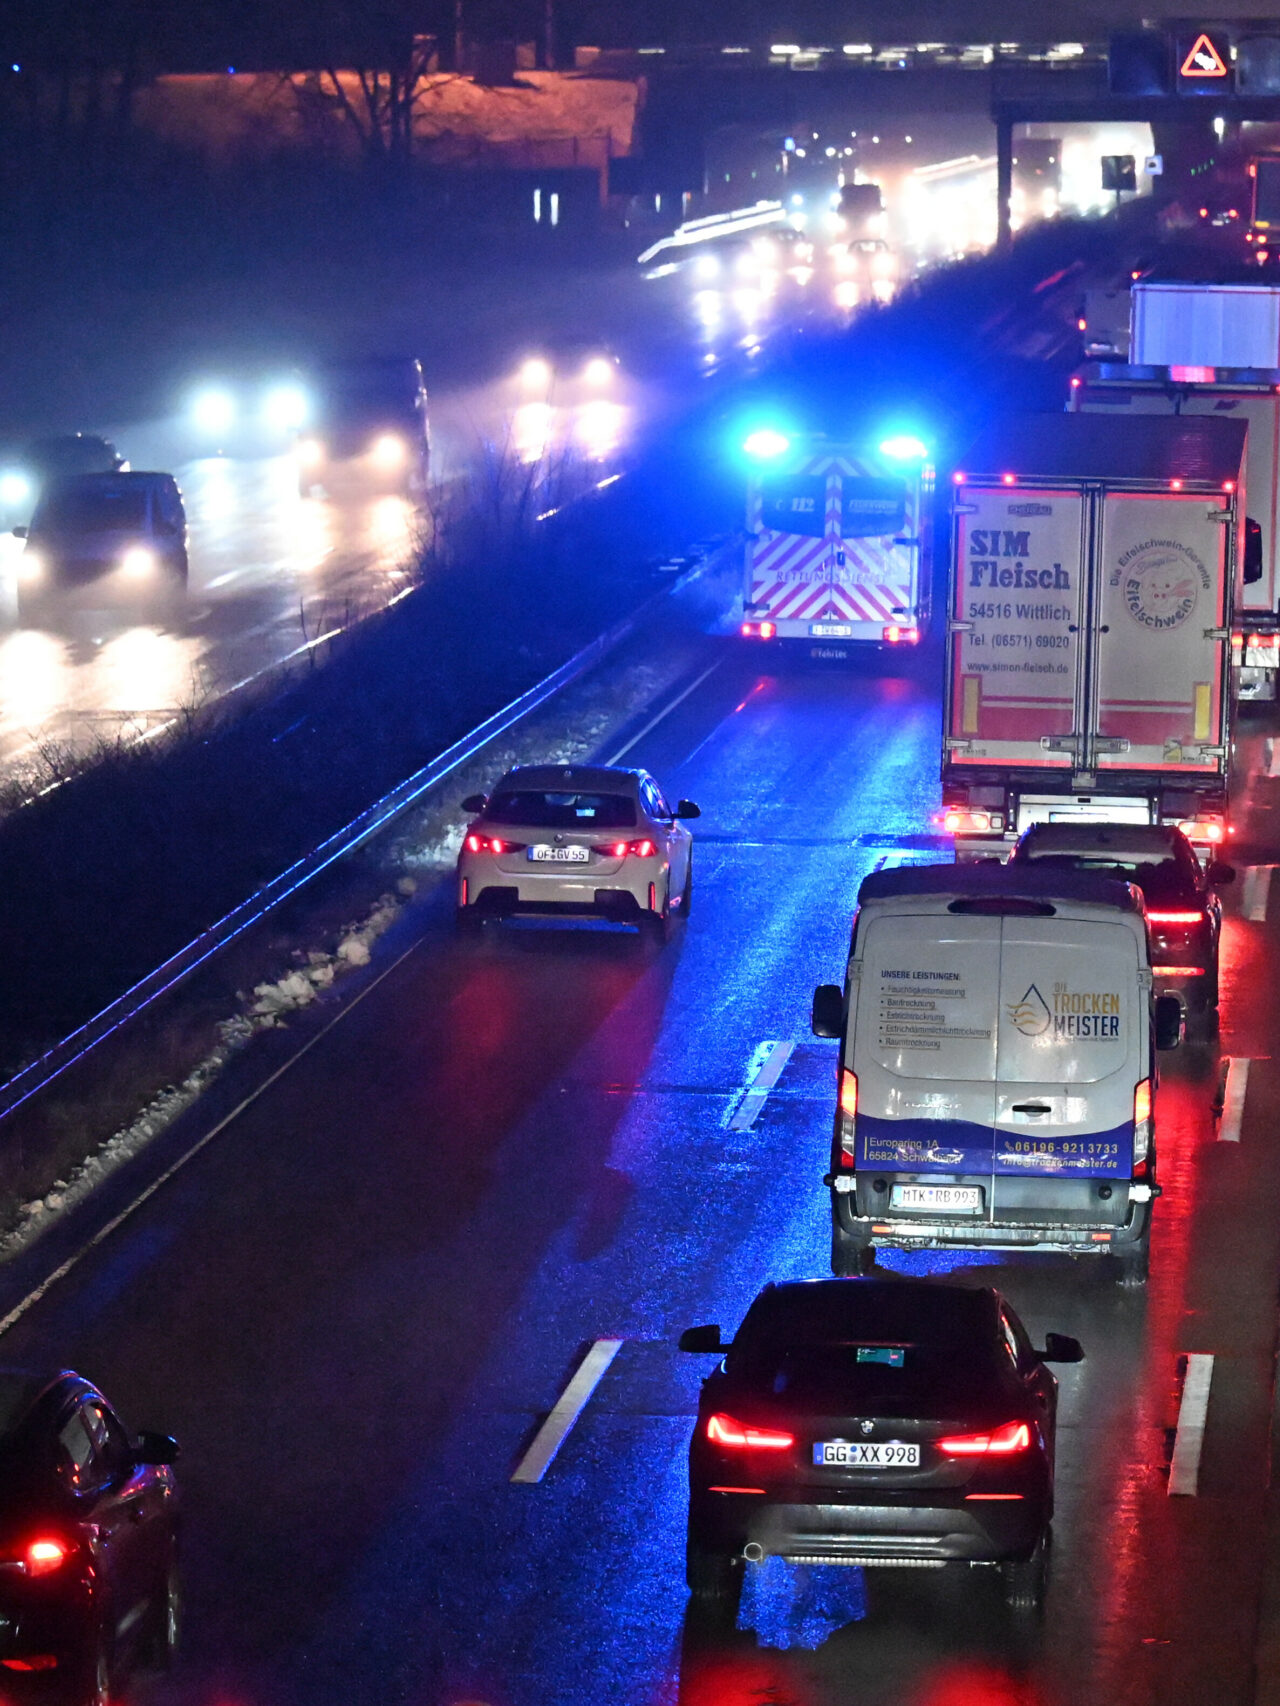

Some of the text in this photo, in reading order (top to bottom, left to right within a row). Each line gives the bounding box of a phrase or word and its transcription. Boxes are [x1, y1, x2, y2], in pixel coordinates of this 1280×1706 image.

[970, 530, 1031, 557] SIM
[969, 561, 1071, 590] Fleisch
[1126, 579, 1193, 628] Eifelschwein
[969, 603, 1071, 621] 54516 Wittlich
[991, 634, 1033, 650] (06571)
[1035, 636, 1070, 649] 69020
[967, 662, 1069, 674] www.simon-fleisch.de
[537, 850, 551, 860] OF
[556, 850, 571, 860] GV
[881, 970, 911, 979] UNSERE
[1054, 982, 1067, 992] DIE
[1053, 993, 1120, 1014] TROCKEN
[1054, 1016, 1120, 1037] MEISTER
[869, 1137, 939, 1150] Europaring 1A
[1015, 1142, 1119, 1154] 06196-9213733
[868, 1151, 899, 1161] 65824
[902, 1189, 977, 1204] MTK RB 993
[824, 1446, 917, 1464] GG XX 998
